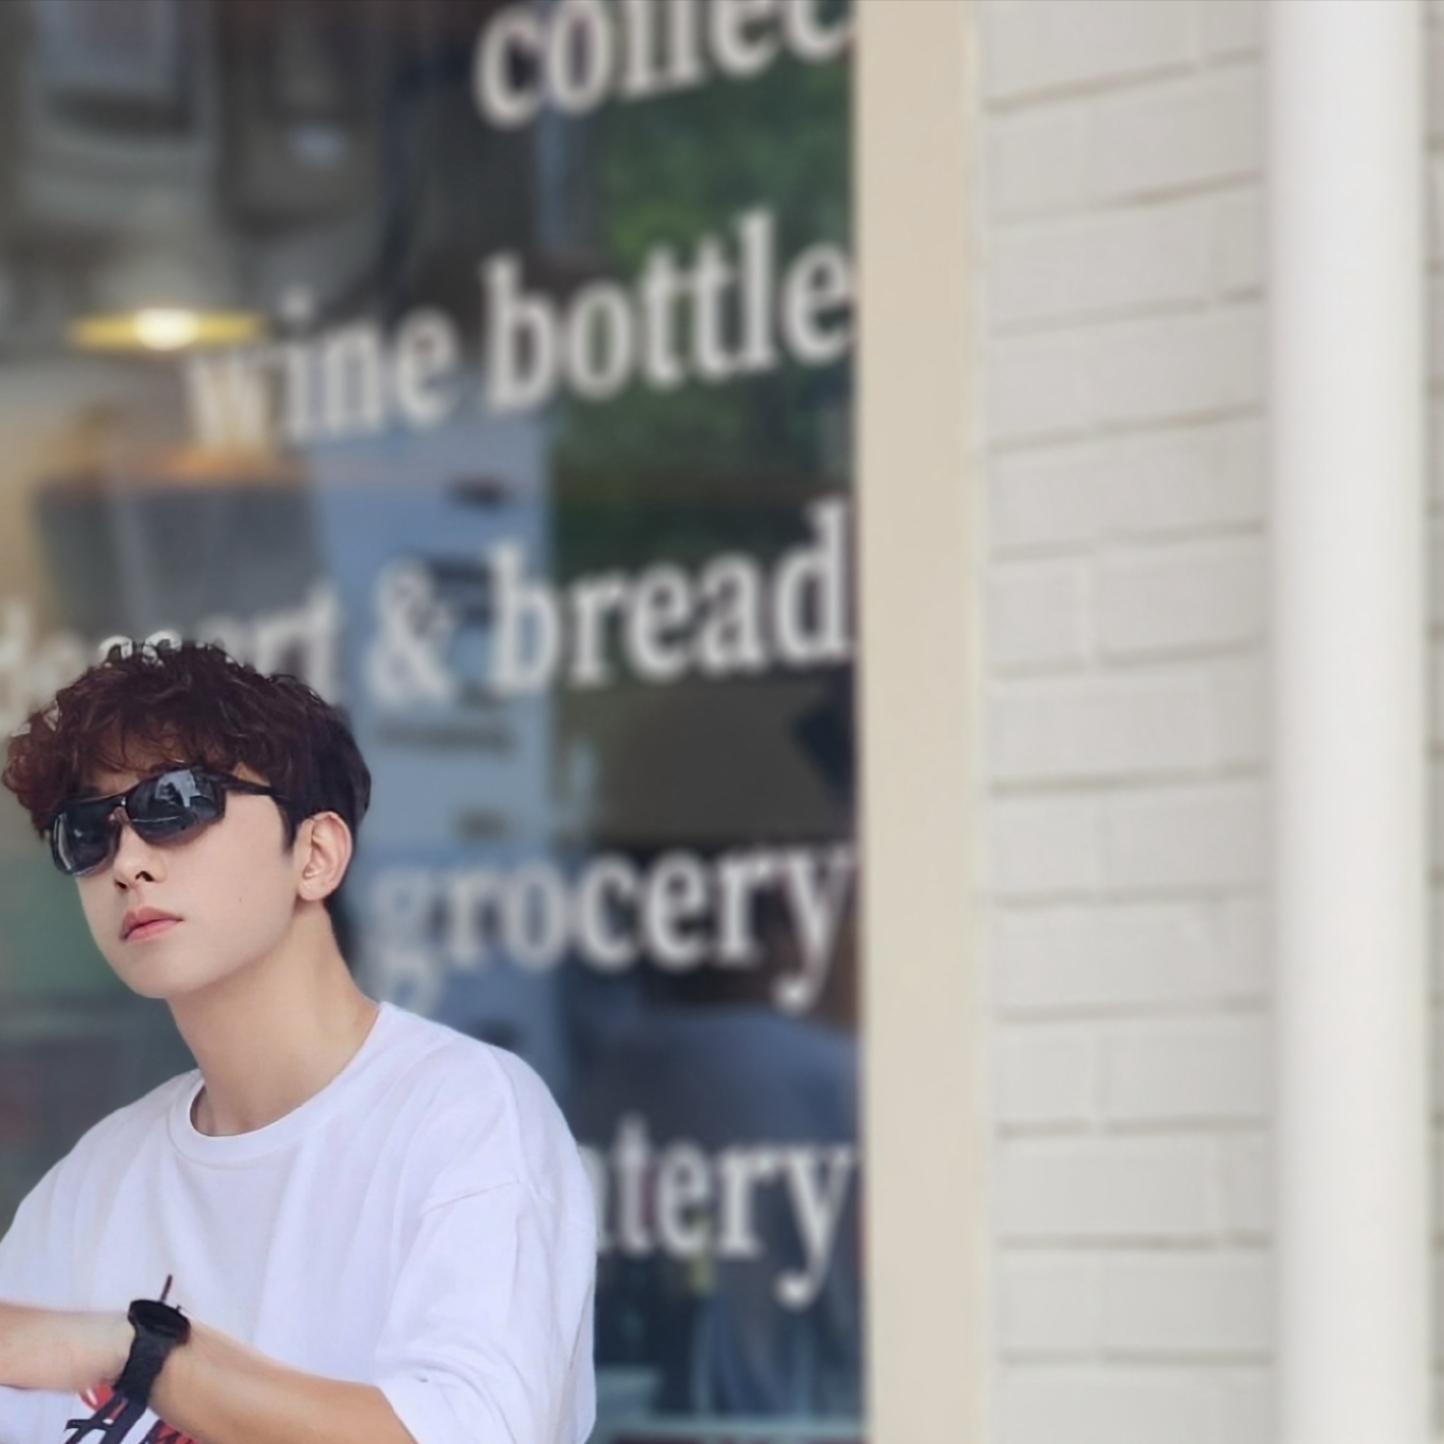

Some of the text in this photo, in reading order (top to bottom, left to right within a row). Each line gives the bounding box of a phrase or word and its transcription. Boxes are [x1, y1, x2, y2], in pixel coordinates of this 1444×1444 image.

[183, 210, 854, 452] wine bottle
[368, 560, 452, 703] &
[492, 498, 852, 692] bread
[370, 847, 854, 1014] grocery
